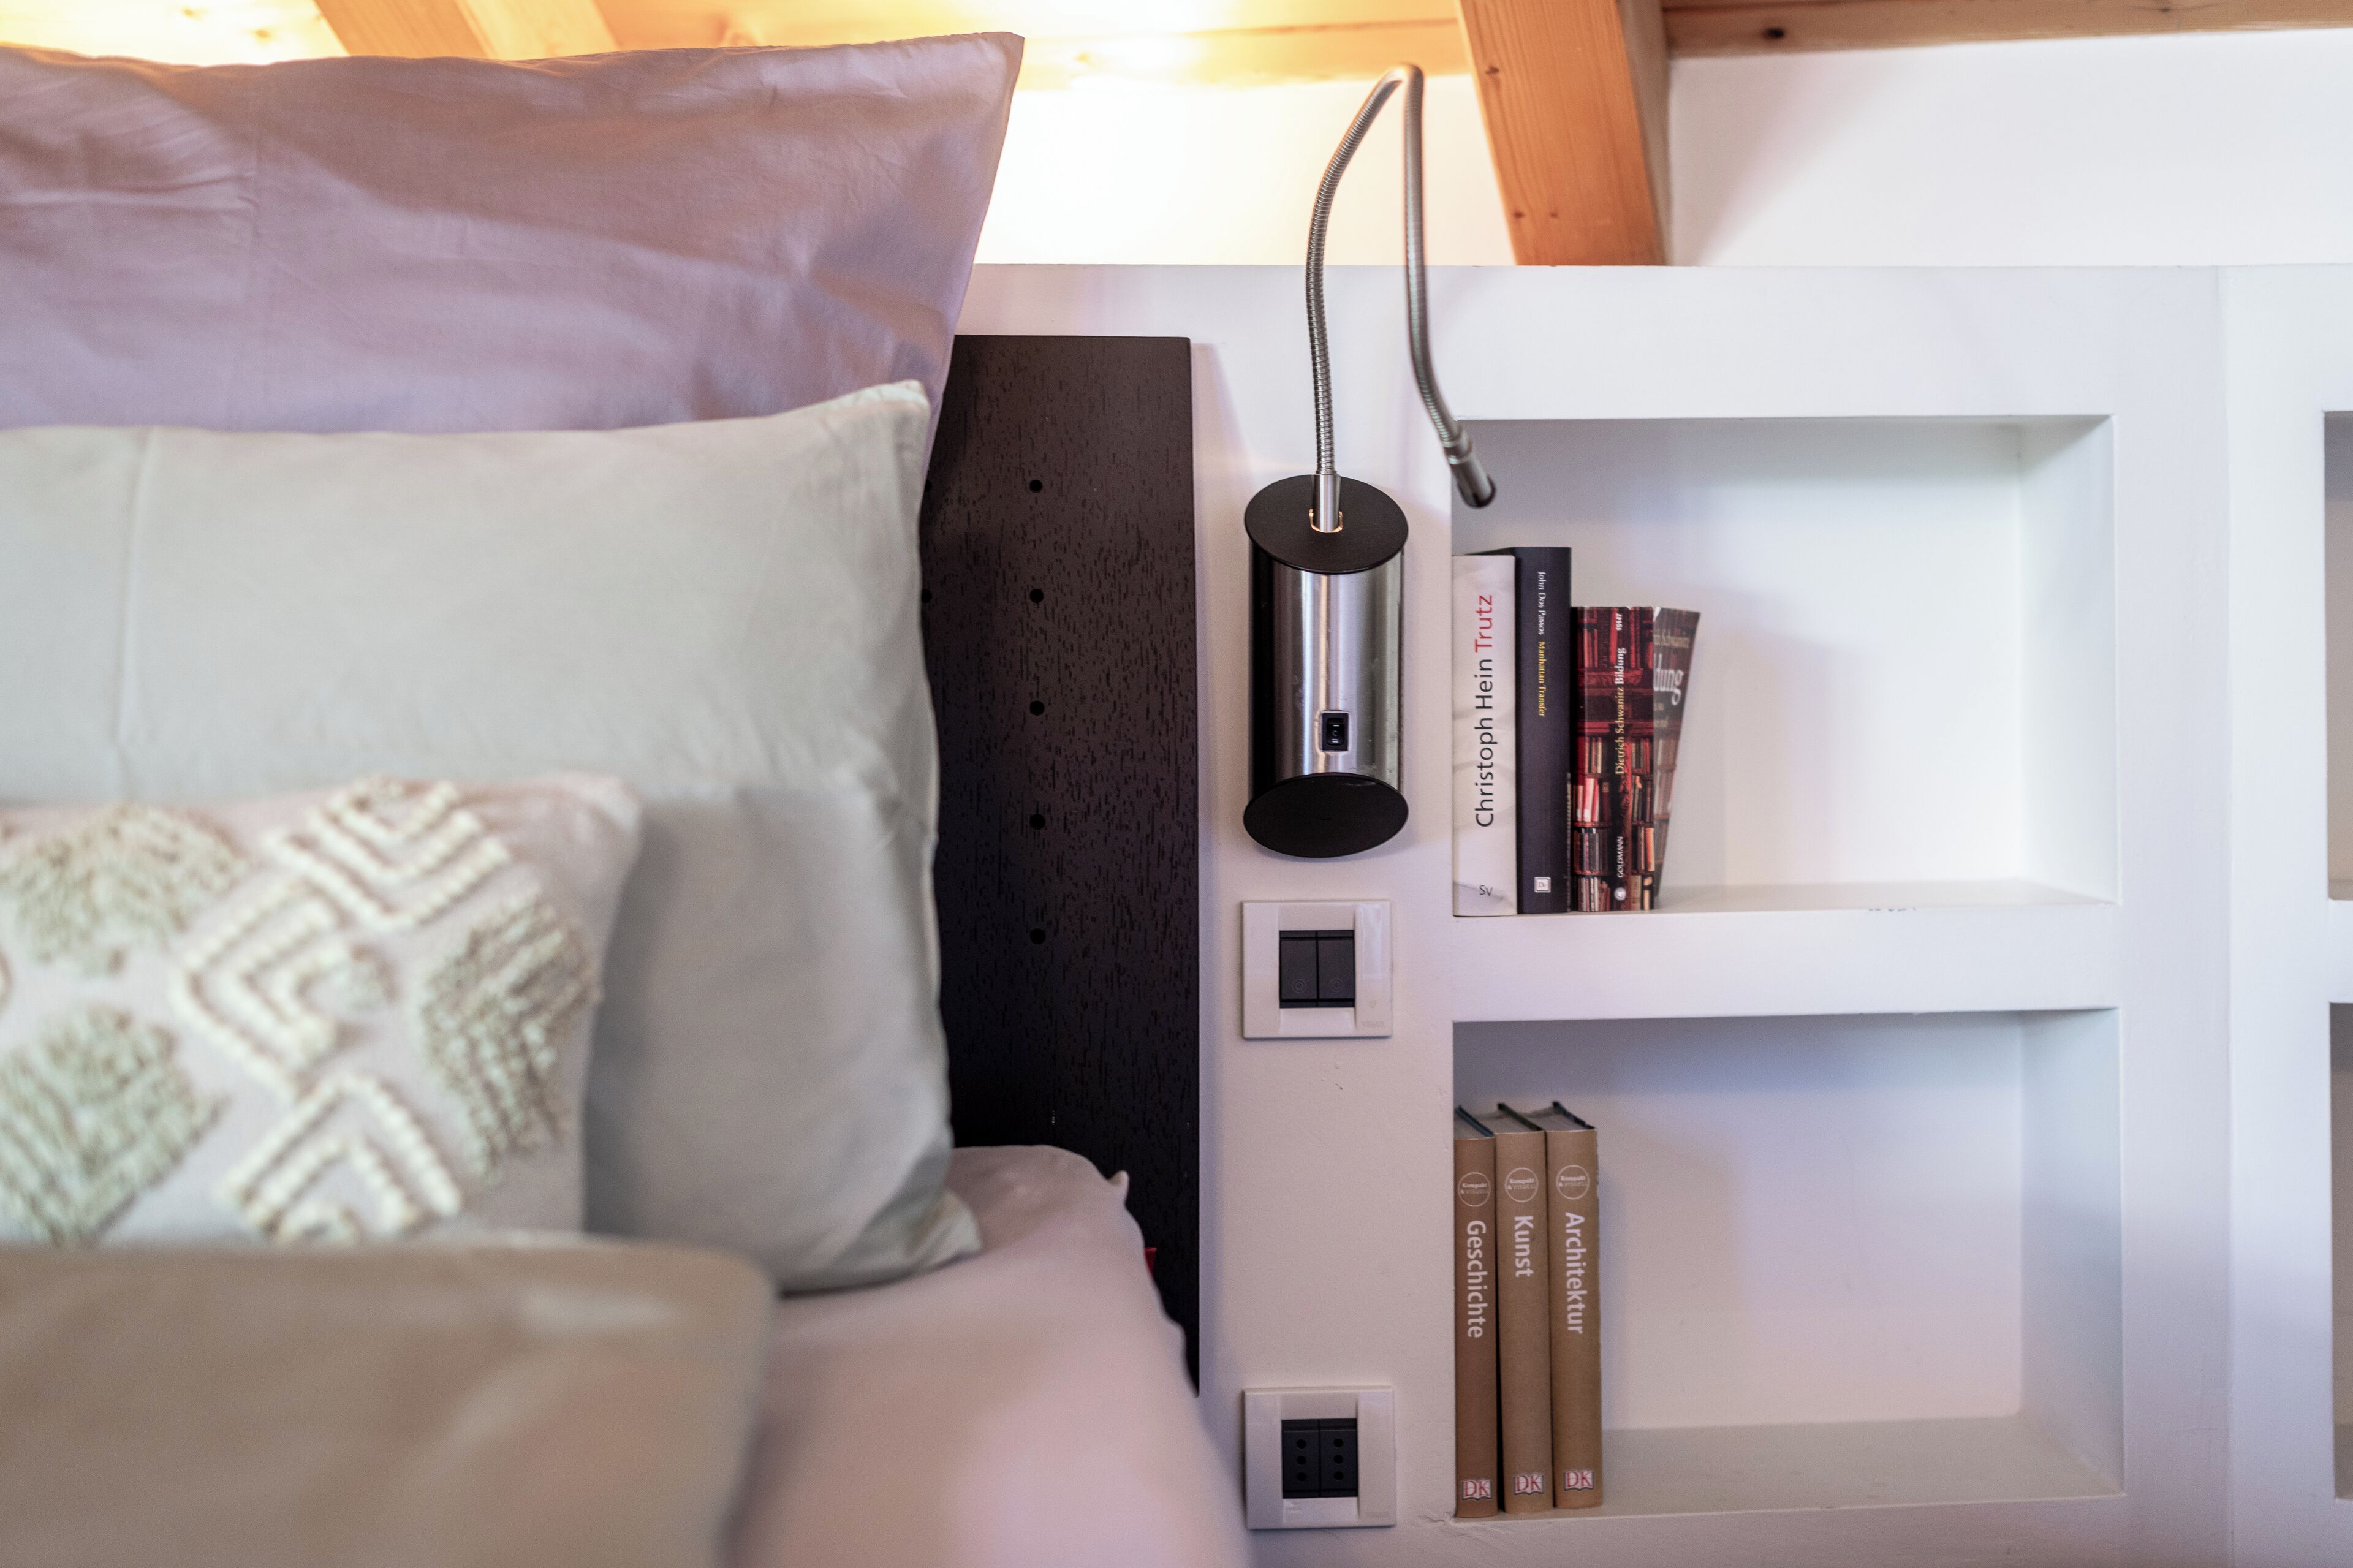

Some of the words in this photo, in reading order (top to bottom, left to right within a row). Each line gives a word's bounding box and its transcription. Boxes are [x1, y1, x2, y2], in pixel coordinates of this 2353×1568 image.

[1537, 571, 1547, 590] John
[1537, 593, 1546, 608] Dos
[1474, 594, 1493, 653] Trutz
[1537, 610, 1546, 635] Passos
[1538, 642, 1547, 683] Manhattan
[1614, 648, 1627, 684] Bildung
[1474, 659, 1493, 710] Hein
[1538, 685, 1547, 717] Transfer
[1615, 686, 1625, 734] Schwanitz
[1474, 717, 1498, 827] Christoph
[1615, 737, 1625, 775] Dietrich
[1514, 1216, 1534, 1278] Kunst
[1467, 1220, 1488, 1338] Geschichte
[1565, 1211, 1588, 1335] Architektur
[1464, 1479, 1491, 1498] DK
[1516, 1474, 1542, 1492] DK
[1567, 1470, 1594, 1488] DK
